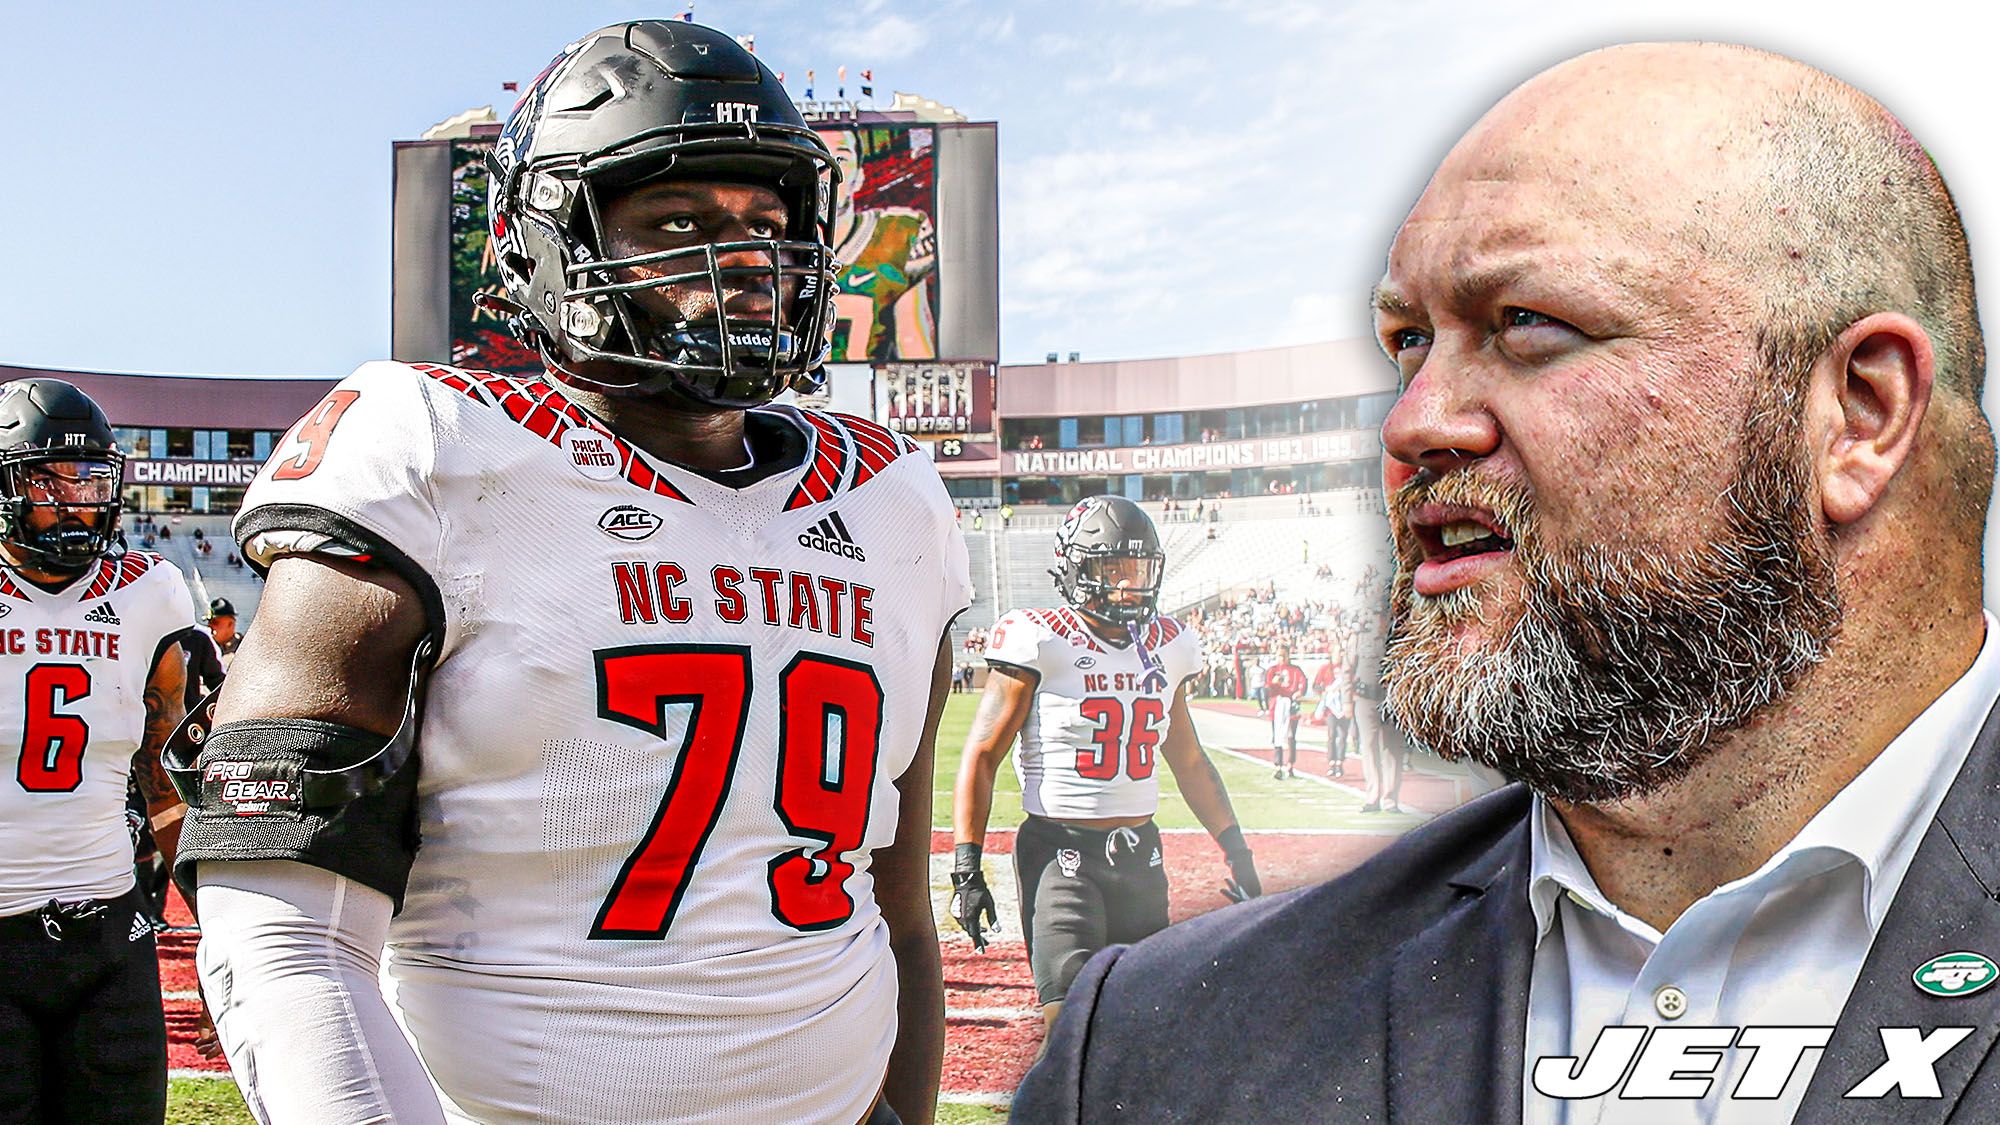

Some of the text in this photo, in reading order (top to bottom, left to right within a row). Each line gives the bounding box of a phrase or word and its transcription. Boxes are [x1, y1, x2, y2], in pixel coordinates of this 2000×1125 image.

[716, 102, 759, 123] HTT
[728, 333, 773, 346] Ridde
[65, 433, 86, 446] HTT
[572, 452, 615, 467] UNITED
[1015, 451, 1123, 473] NATIONAL
[1132, 443, 1254, 469] CHAMPIONS
[134, 462, 262, 483] CHAMPIONS
[608, 513, 653, 527] ACC
[798, 533, 866, 562] adidas
[611, 561, 875, 648] NC STATE
[84, 613, 121, 626] adidas
[35, 628, 121, 661] STATE
[1084, 673, 1109, 693] NC
[16, 662, 92, 793] 6
[1074, 696, 1167, 781] 36
[206, 761, 254, 781] PRO
[588, 643, 885, 941] 79
[236, 802, 271, 813] schutt
